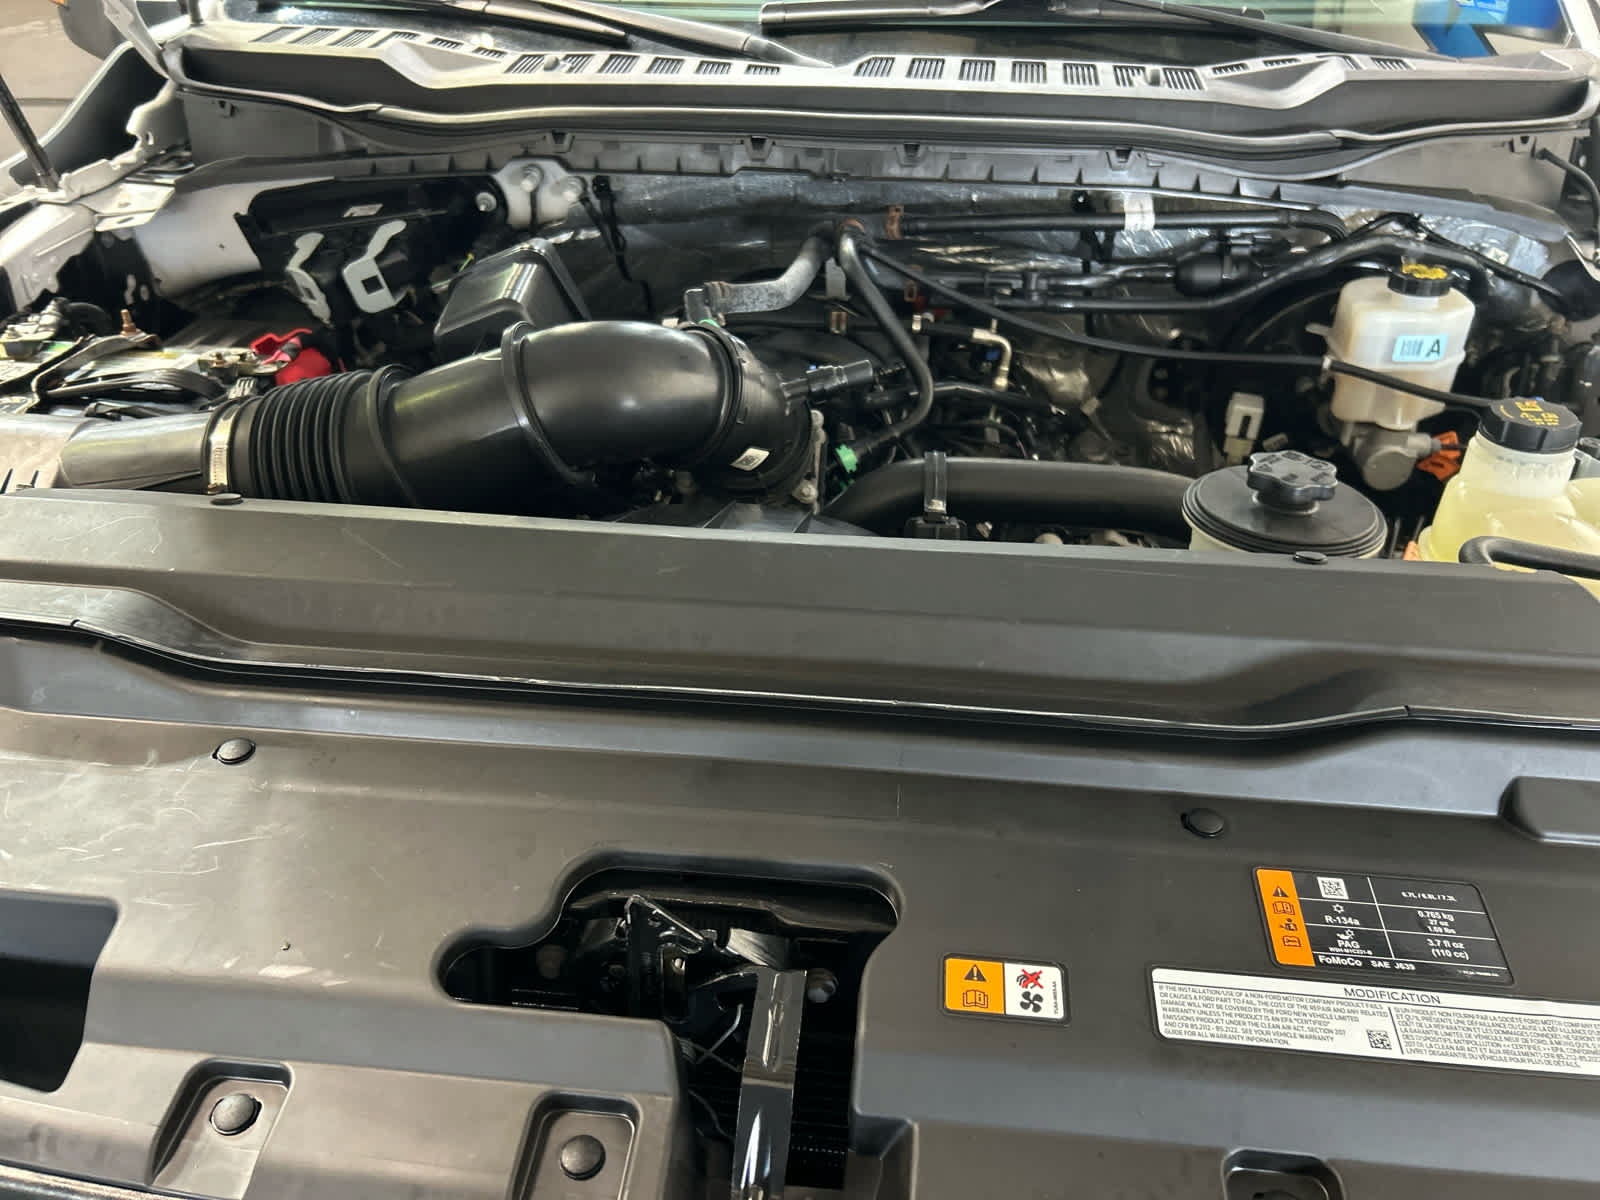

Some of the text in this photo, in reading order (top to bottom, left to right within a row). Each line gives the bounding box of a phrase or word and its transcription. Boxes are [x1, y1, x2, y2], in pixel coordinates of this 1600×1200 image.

[1425, 339, 1441, 357] A
[1324, 915, 1360, 925] R-134a
[1442, 912, 1454, 921] kg
[1336, 939, 1360, 948] PAG
[1426, 938, 1464, 949] 3.7 fl oz
[1431, 948, 1468, 960] (110 cc)
[1318, 954, 1415, 970] FoMoCo SAE J639
[1343, 987, 1440, 1004] MODIFICATION
[1160, 999, 1185, 1007] DAMAGE
[1305, 997, 1334, 1005] COMPANY
[1336, 999, 1364, 1007] PRODUCT
[1162, 1006, 1195, 1015] WARRANTY
[1197, 1009, 1220, 1017] UNLESS
[1234, 1012, 1262, 1020] PRODUCT
[1309, 1004, 1331, 1012] REPAIR
[1360, 1008, 1388, 1016] RELATED
[1162, 1014, 1194, 1022] EMISSIONS
[1196, 1016, 1223, 1024] PRODUCT
[1209, 1032, 1244, 1041] WARRANTY
[1272, 1030, 1297, 1038] VEHICLE
[1299, 1032, 1333, 1041] WARRANTY
